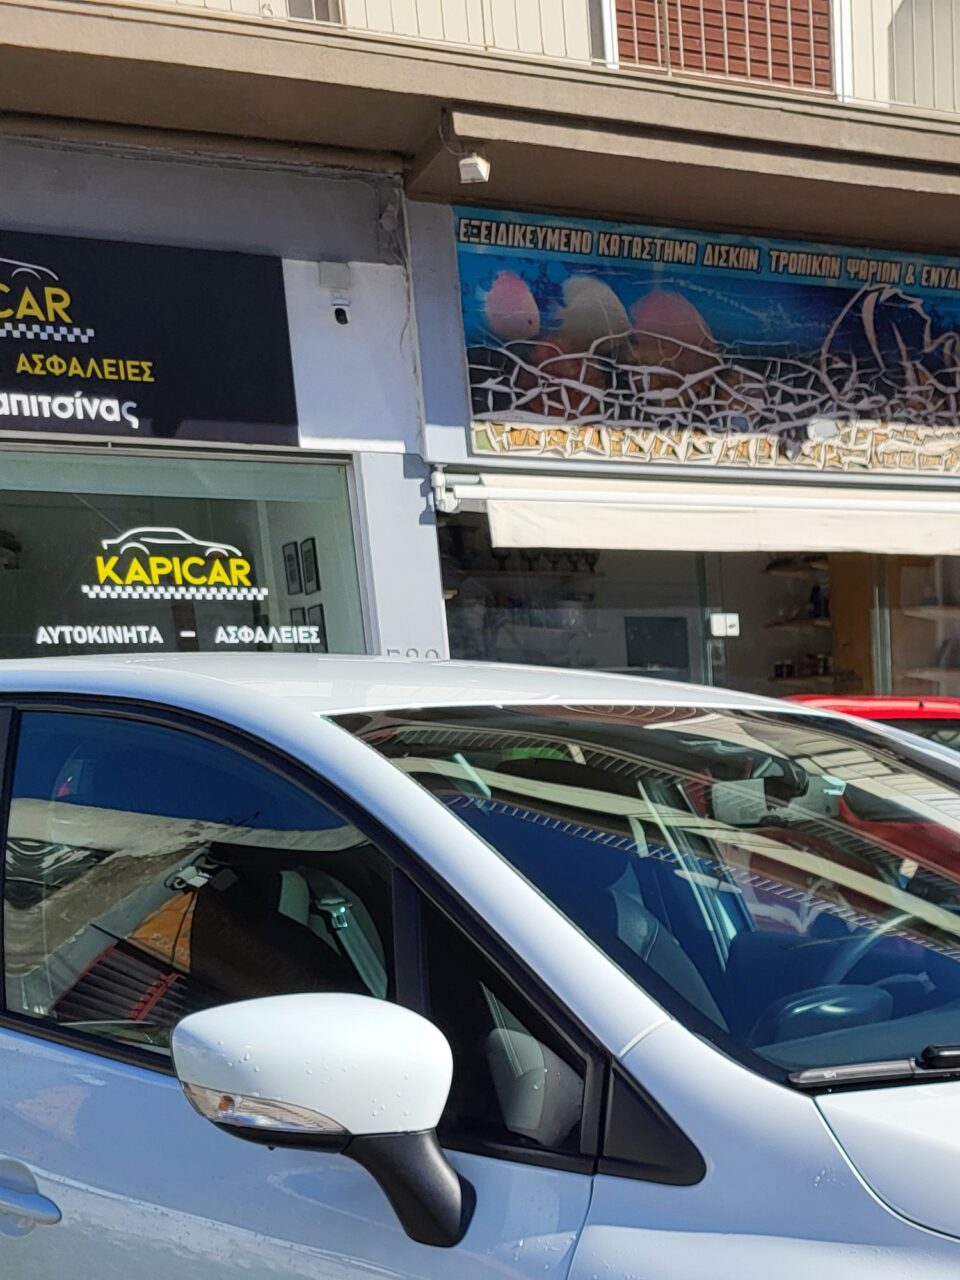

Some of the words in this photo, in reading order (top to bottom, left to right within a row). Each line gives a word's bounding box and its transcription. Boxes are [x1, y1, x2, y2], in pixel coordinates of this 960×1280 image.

[458, 218, 593, 255] ΕΞΕΙΔΙΚΕΥΜΕΝΟ
[598, 232, 698, 266] ΚΑΤΑΣΤΗΜΑ
[769, 249, 841, 279] ΤΡΟΠΙΚΩΝ
[904, 265, 915, 286] &
[16, 352, 155, 383] ΑΣΦΑΛΕΙΕΣ
[95, 555, 252, 587] KAPICAR
[36, 624, 164, 646] ΑΥΤΟΚΙΝΗΤΑ
[214, 625, 321, 645] ΑΣΦΑΛΕΙΕΣ
